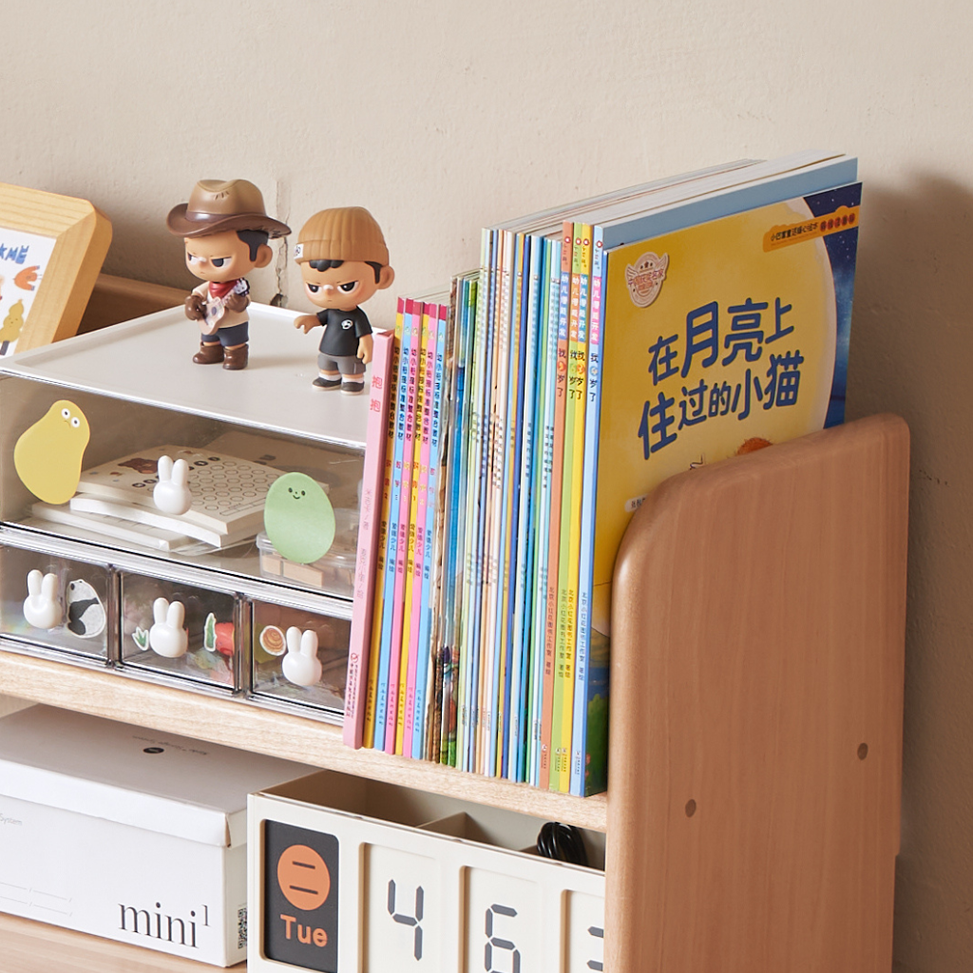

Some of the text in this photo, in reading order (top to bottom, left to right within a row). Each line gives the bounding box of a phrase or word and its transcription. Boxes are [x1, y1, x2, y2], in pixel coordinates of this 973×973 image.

[648, 297, 795, 386] 在月亮上
[370, 375, 383, 413] 抱抱
[637, 349, 804, 461] 住过的小猫
[289, 860, 318, 895] 二
[280, 914, 328, 948] Tue
[387, 879, 425, 961] 4
